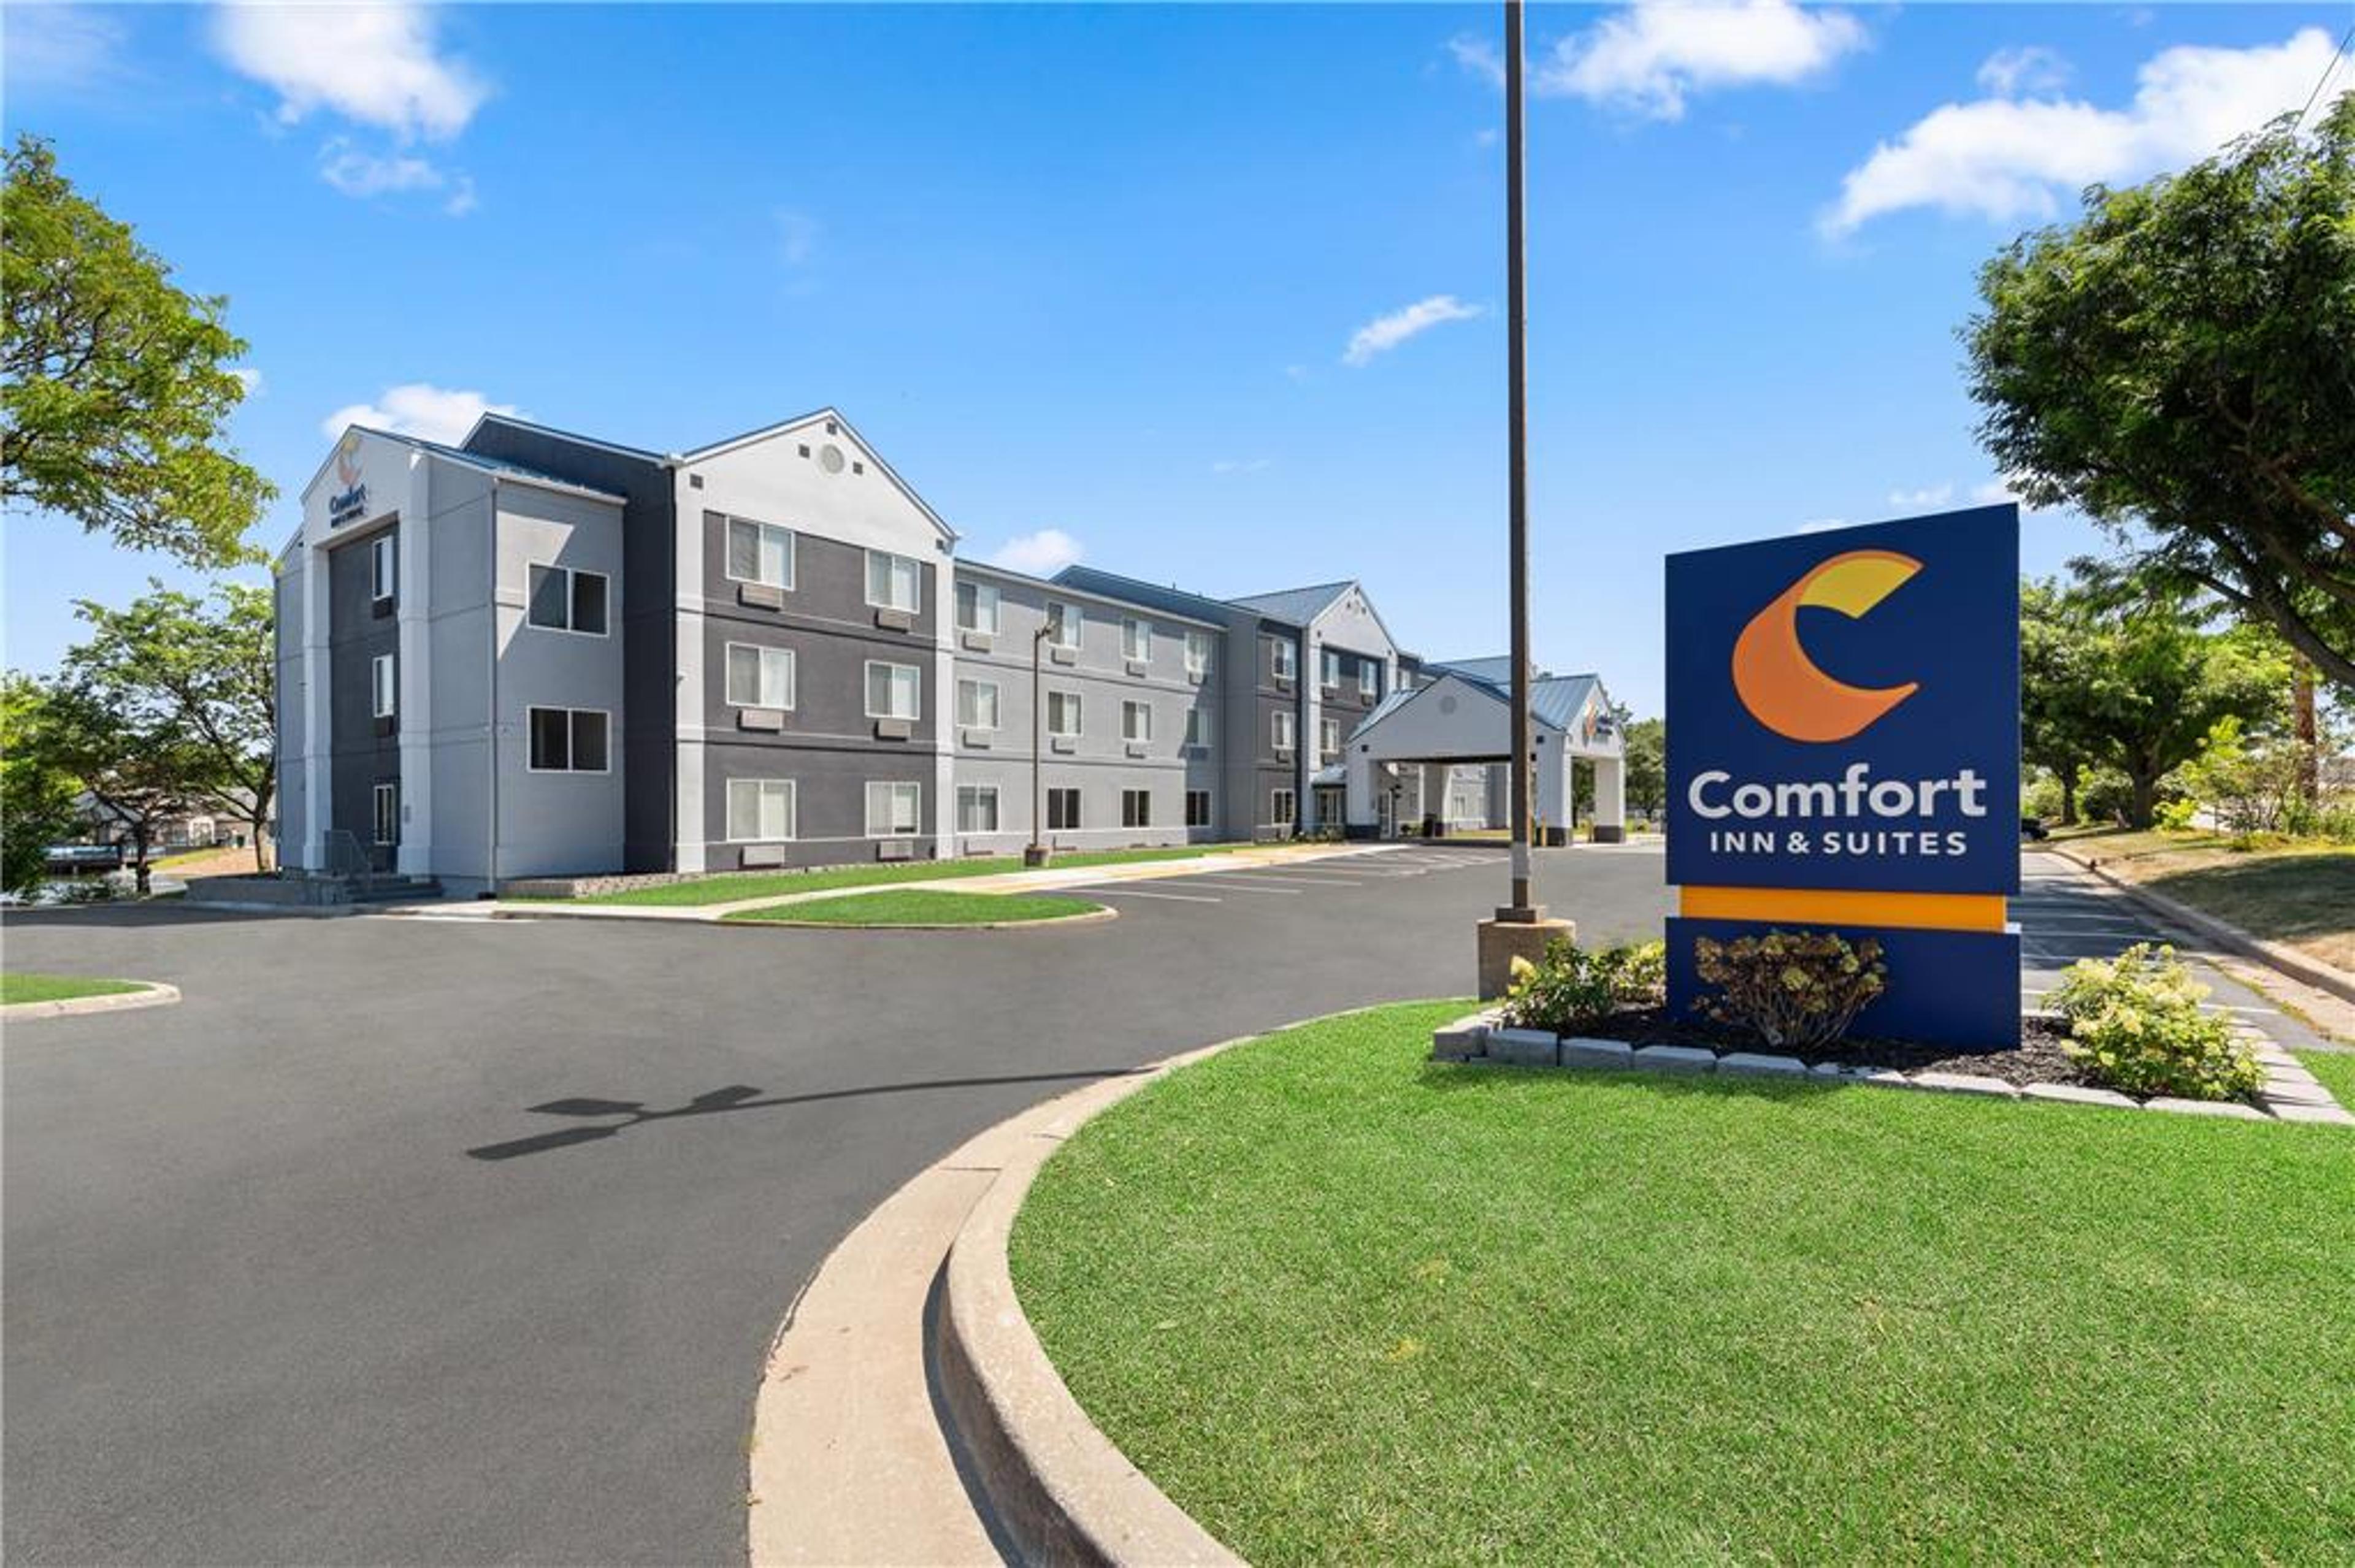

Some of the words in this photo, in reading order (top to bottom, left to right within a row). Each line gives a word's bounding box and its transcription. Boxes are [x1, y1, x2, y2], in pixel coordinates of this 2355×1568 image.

[1688, 763, 1987, 819] Comfort
[1710, 832, 1775, 853] INN
[1786, 831, 1810, 854] &
[1823, 831, 1967, 855] SUITES
